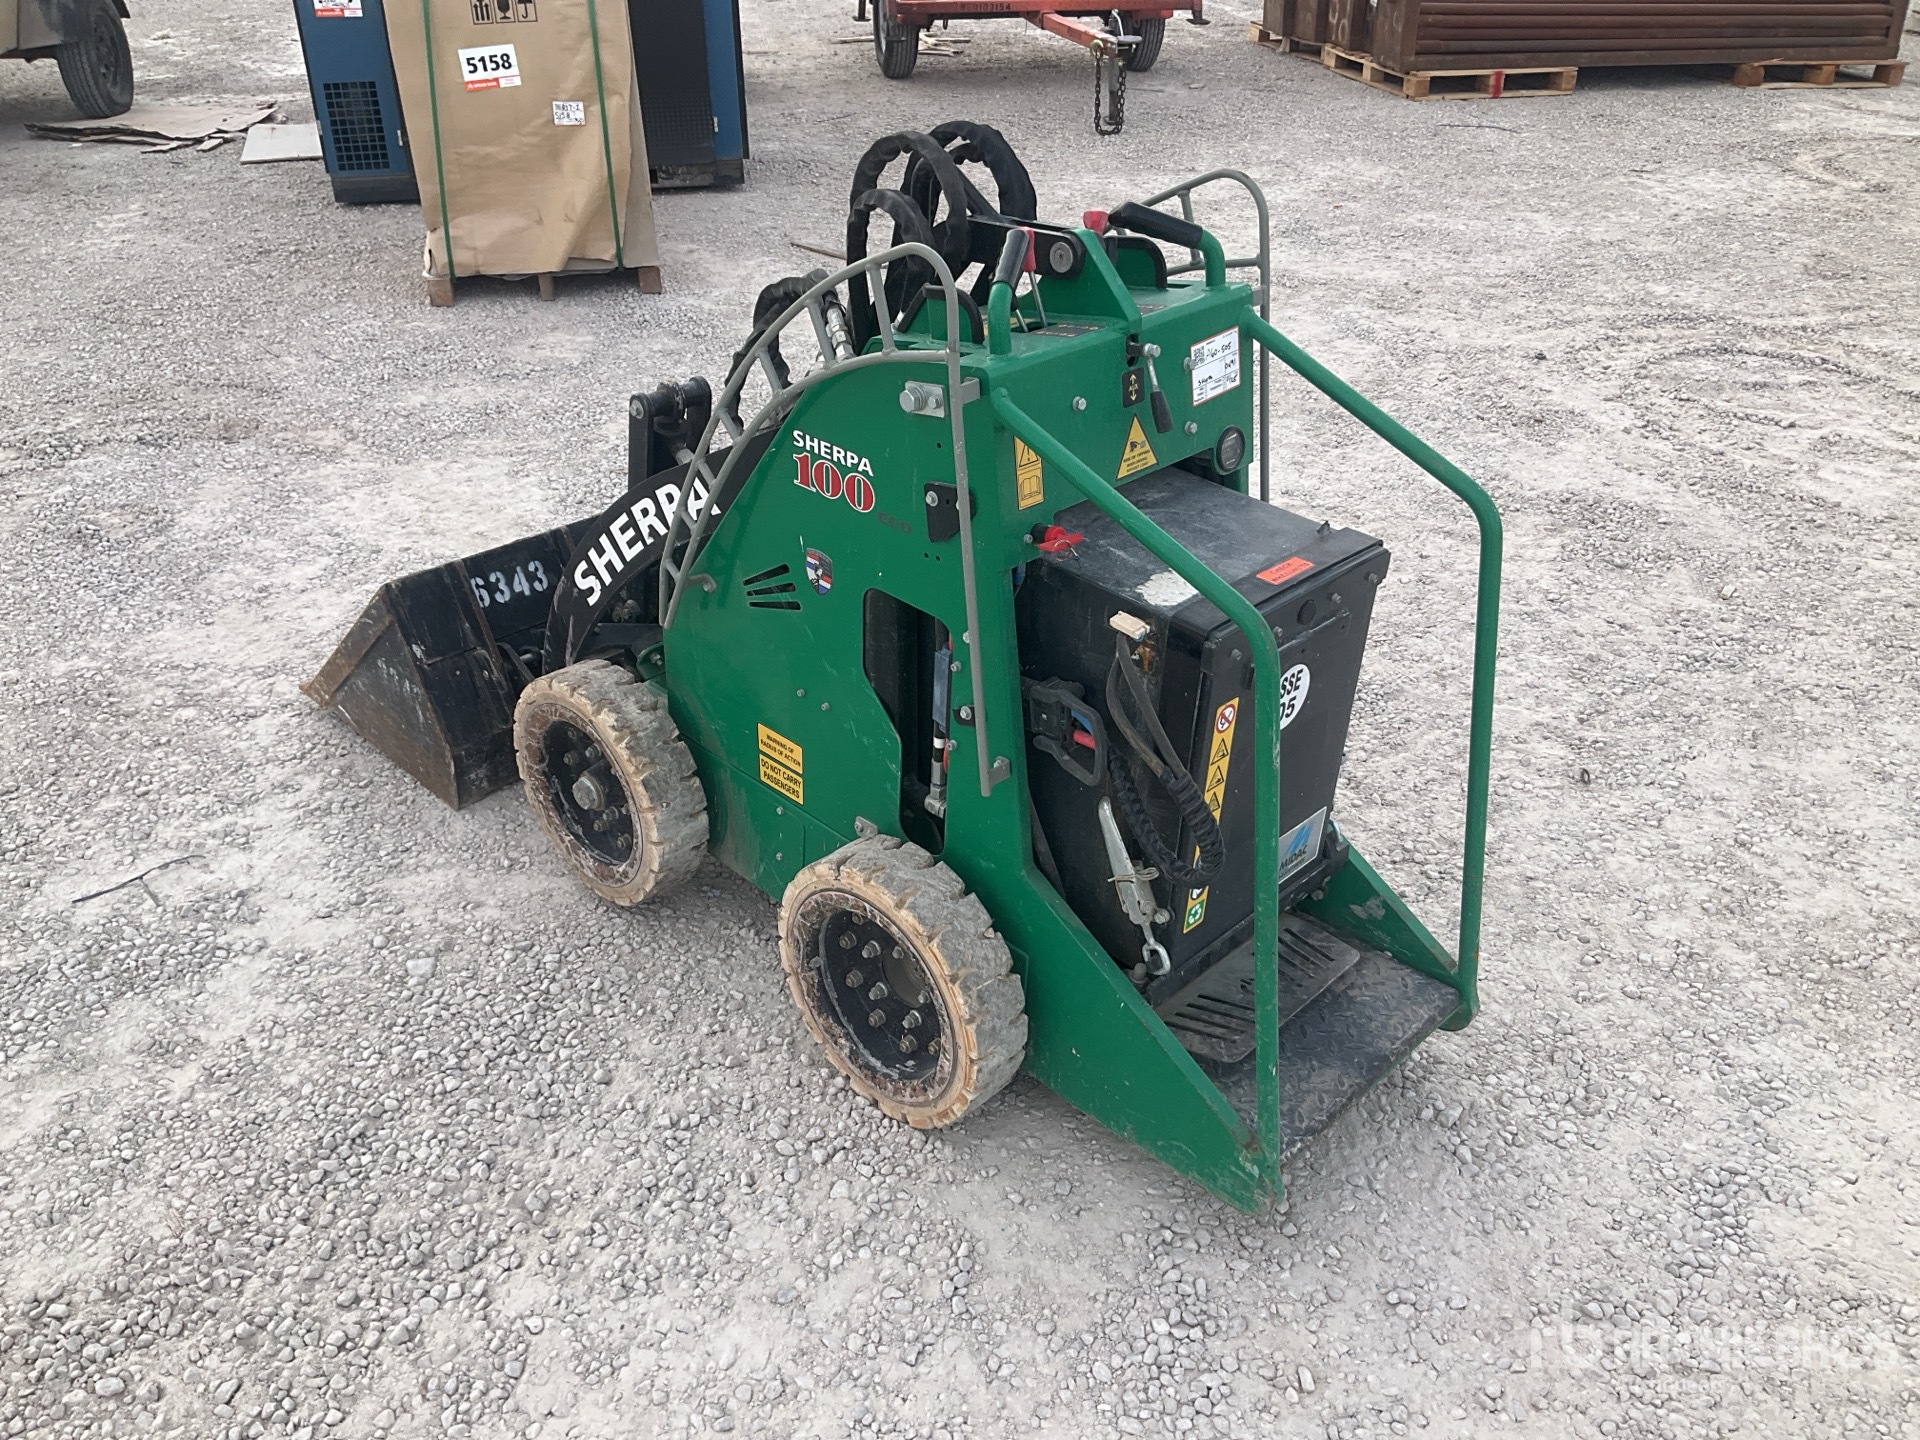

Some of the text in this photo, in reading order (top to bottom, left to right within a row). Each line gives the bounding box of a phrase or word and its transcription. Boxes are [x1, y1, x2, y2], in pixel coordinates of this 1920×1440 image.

[465, 53, 512, 75] 5158
[1128, 383, 1139, 392] AUX
[792, 430, 874, 477] SHERPA
[792, 452, 876, 513] 100
[574, 476, 722, 607] SHERPA
[470, 560, 548, 608] 6343
[760, 738, 801, 767] RADIUS OF ACTION
[766, 734, 787, 751] WARNING
[761, 758, 802, 789] DO NOT CARRY
[763, 770, 800, 799] PASSENGERS
[1279, 844, 1308, 872] MIDAC
